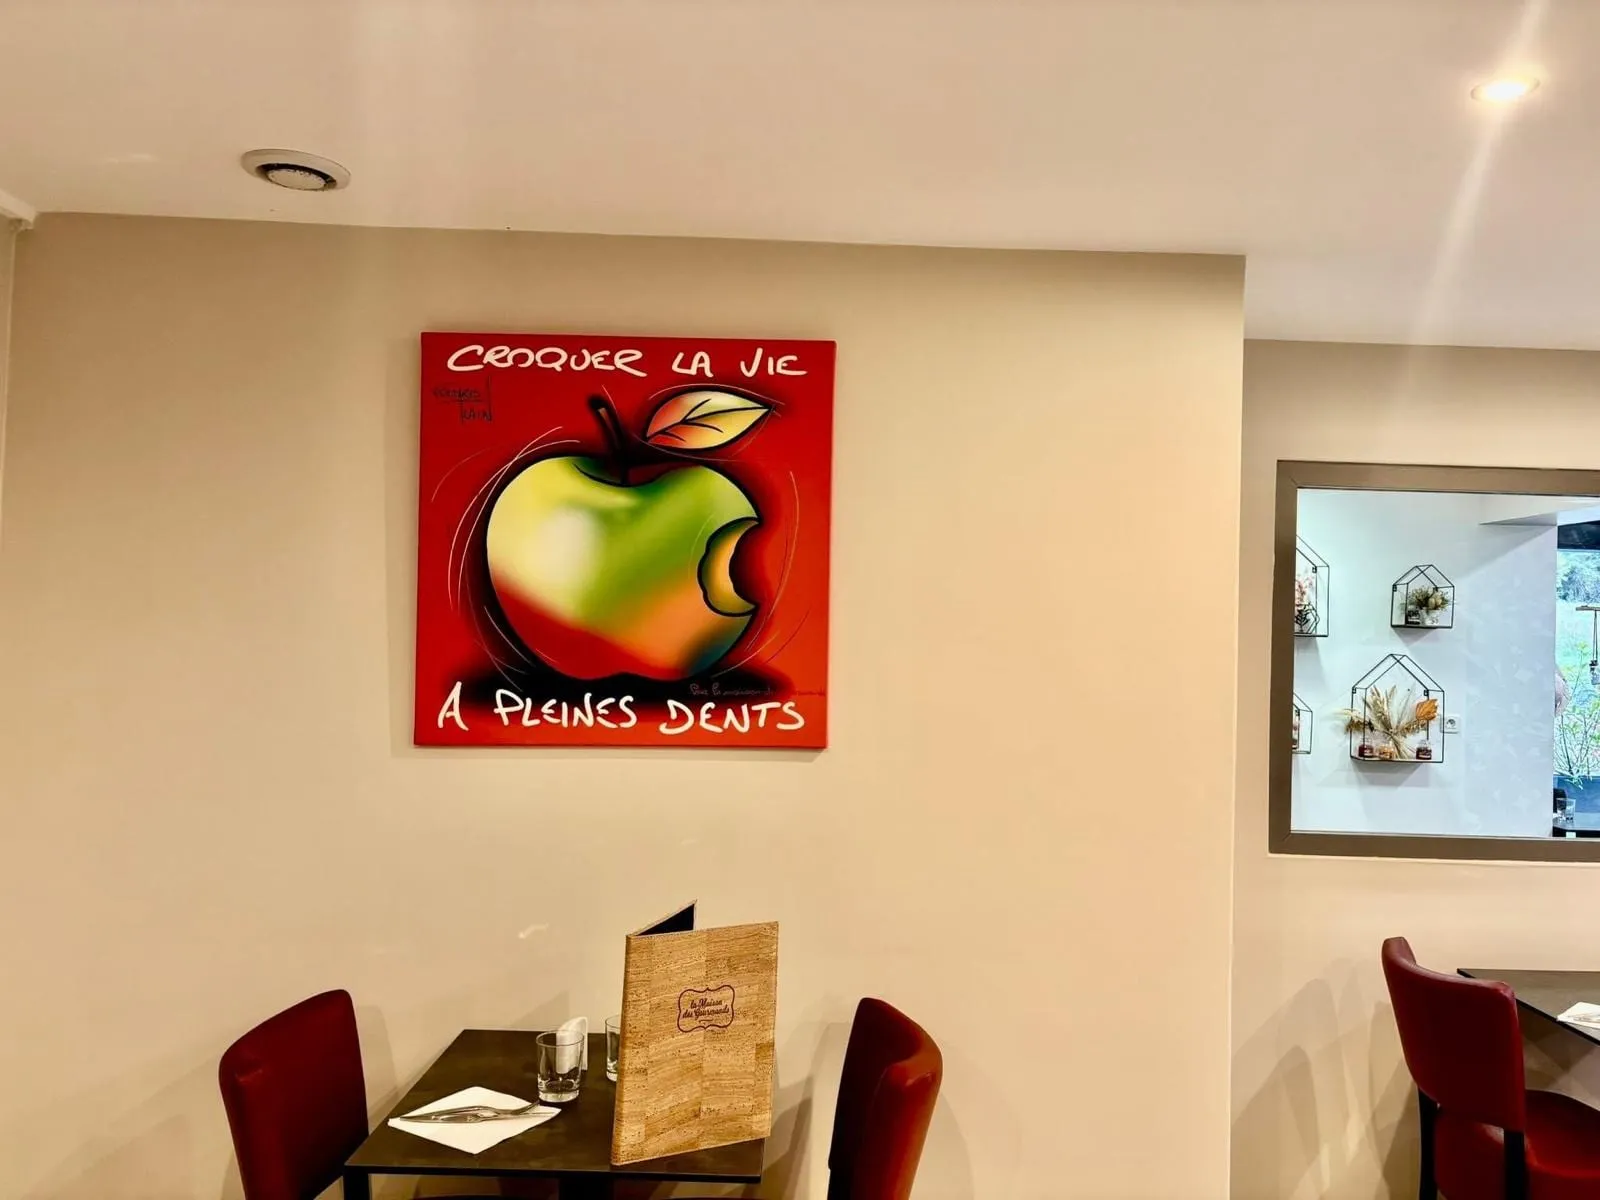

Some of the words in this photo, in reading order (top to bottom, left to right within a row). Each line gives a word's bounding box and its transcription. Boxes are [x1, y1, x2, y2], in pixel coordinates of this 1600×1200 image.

[447, 345, 647, 377] CROQUER
[672, 351, 714, 377] LA
[740, 348, 807, 377] VIE
[437, 682, 469, 730] A
[494, 689, 637, 729] PLEINES
[659, 698, 805, 734] DENTS
[682, 1009, 693, 1018] des
[693, 1004, 729, 1020] Gourmands
[698, 998, 723, 1008] Maison
